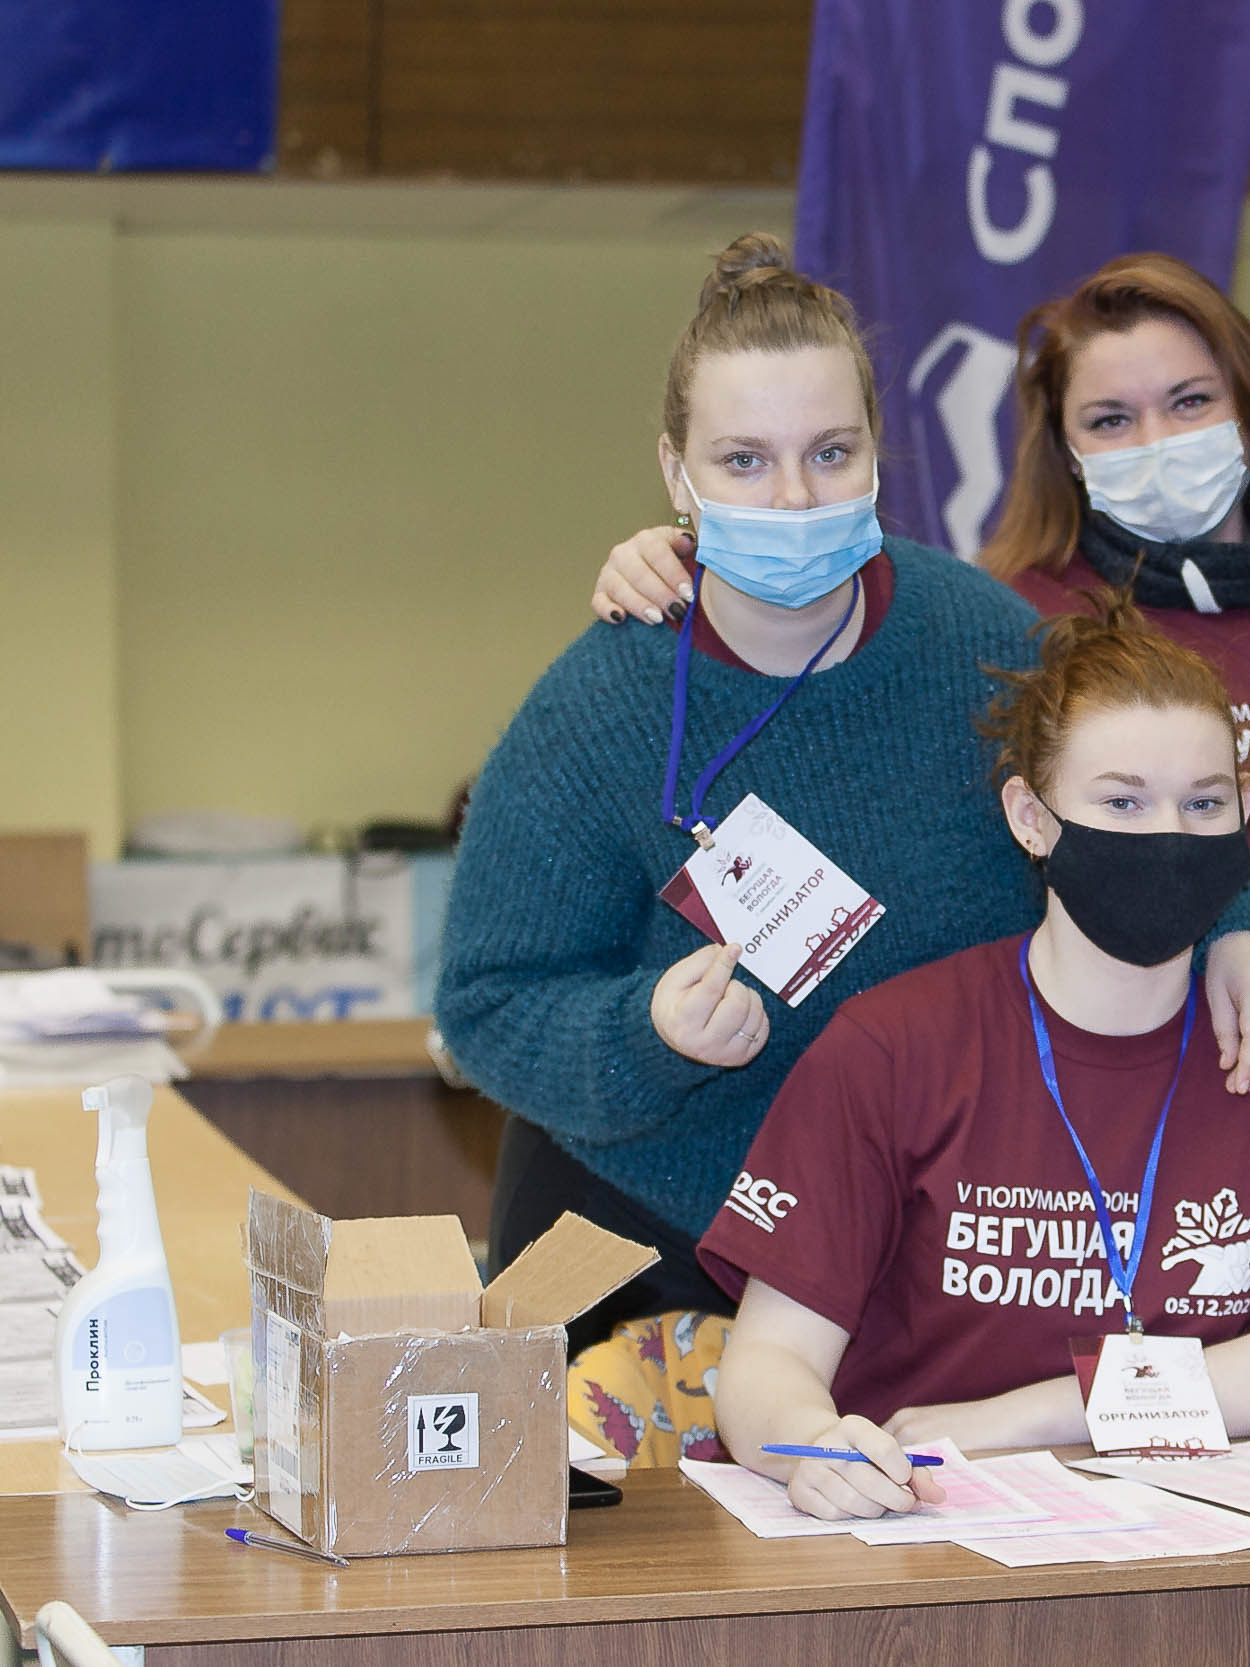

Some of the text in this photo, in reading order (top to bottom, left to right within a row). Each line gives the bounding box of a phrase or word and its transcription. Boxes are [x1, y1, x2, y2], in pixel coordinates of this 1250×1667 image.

[744, 868, 825, 954] ОРГАНИЗАТОР
[86, 1318, 101, 1392] Проклин
[1099, 1409, 1209, 1423] ОРГАНИЗАТОР
[418, 1454, 463, 1465] FRAGILE
